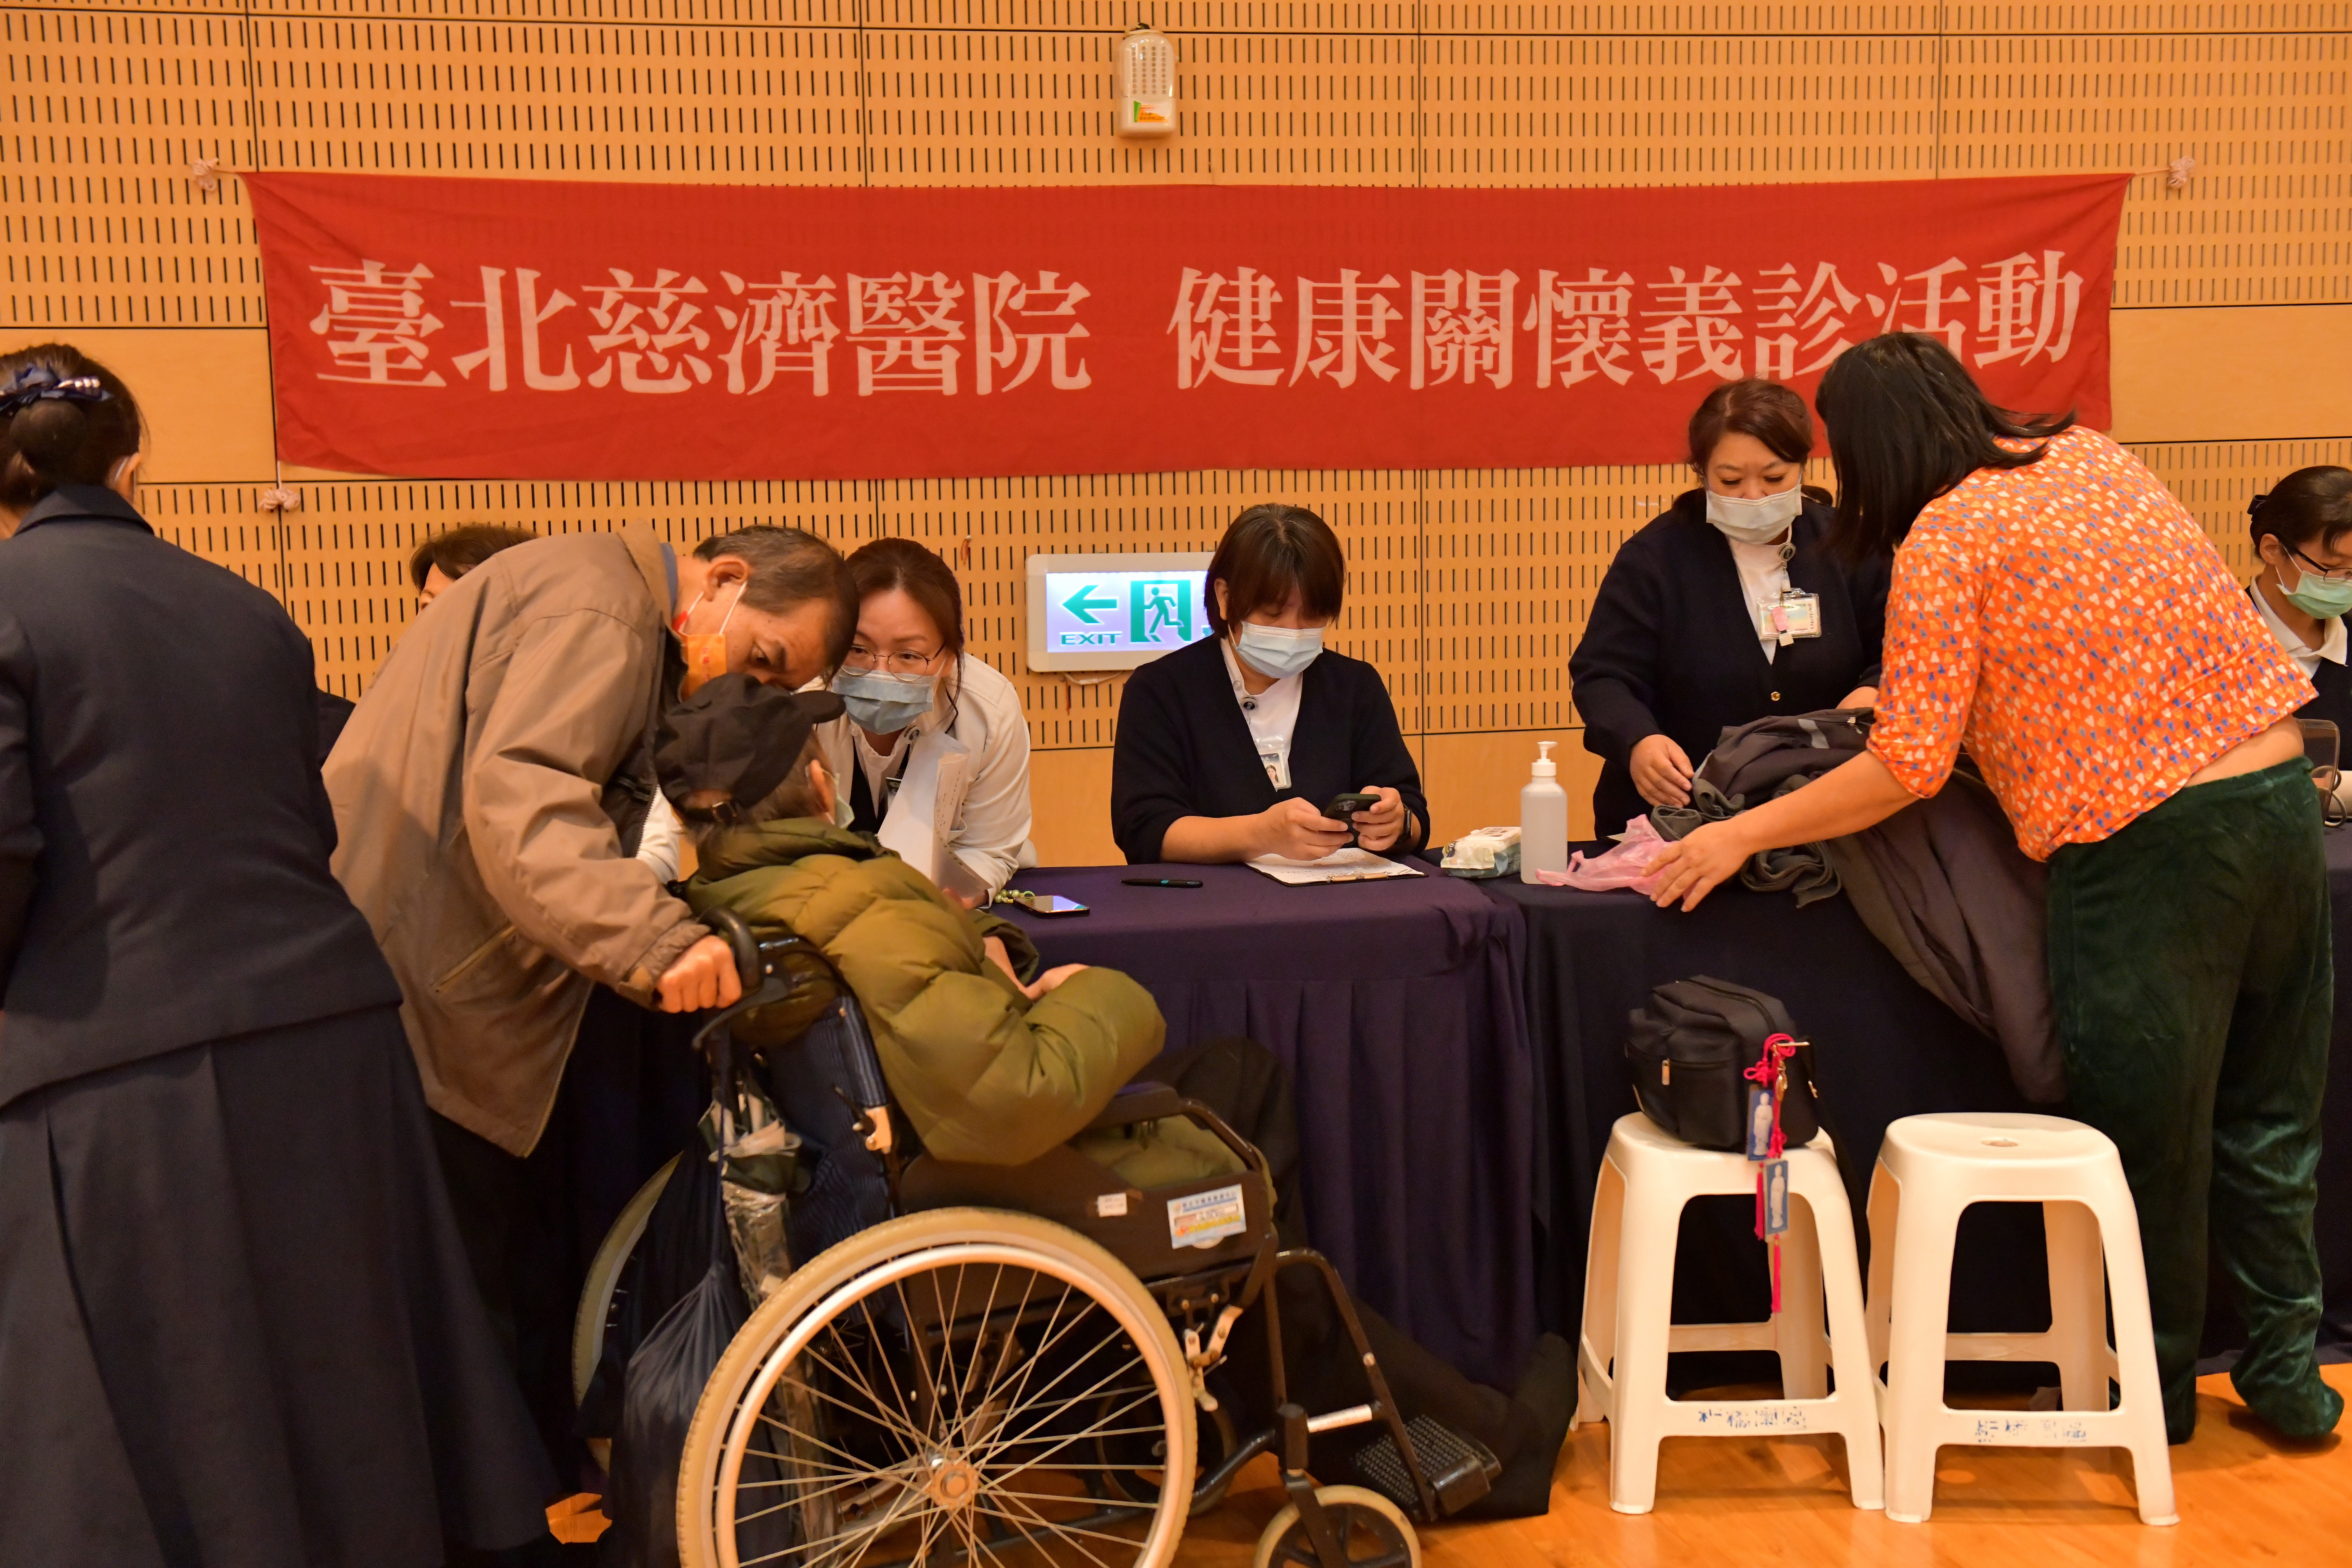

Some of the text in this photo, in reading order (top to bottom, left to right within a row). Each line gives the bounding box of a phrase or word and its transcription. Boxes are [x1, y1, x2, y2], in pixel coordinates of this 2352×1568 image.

[309, 249, 2084, 396] 臺北慈濟醫院 健康關懷義診活動
[1060, 632, 1121, 645] EXIT
